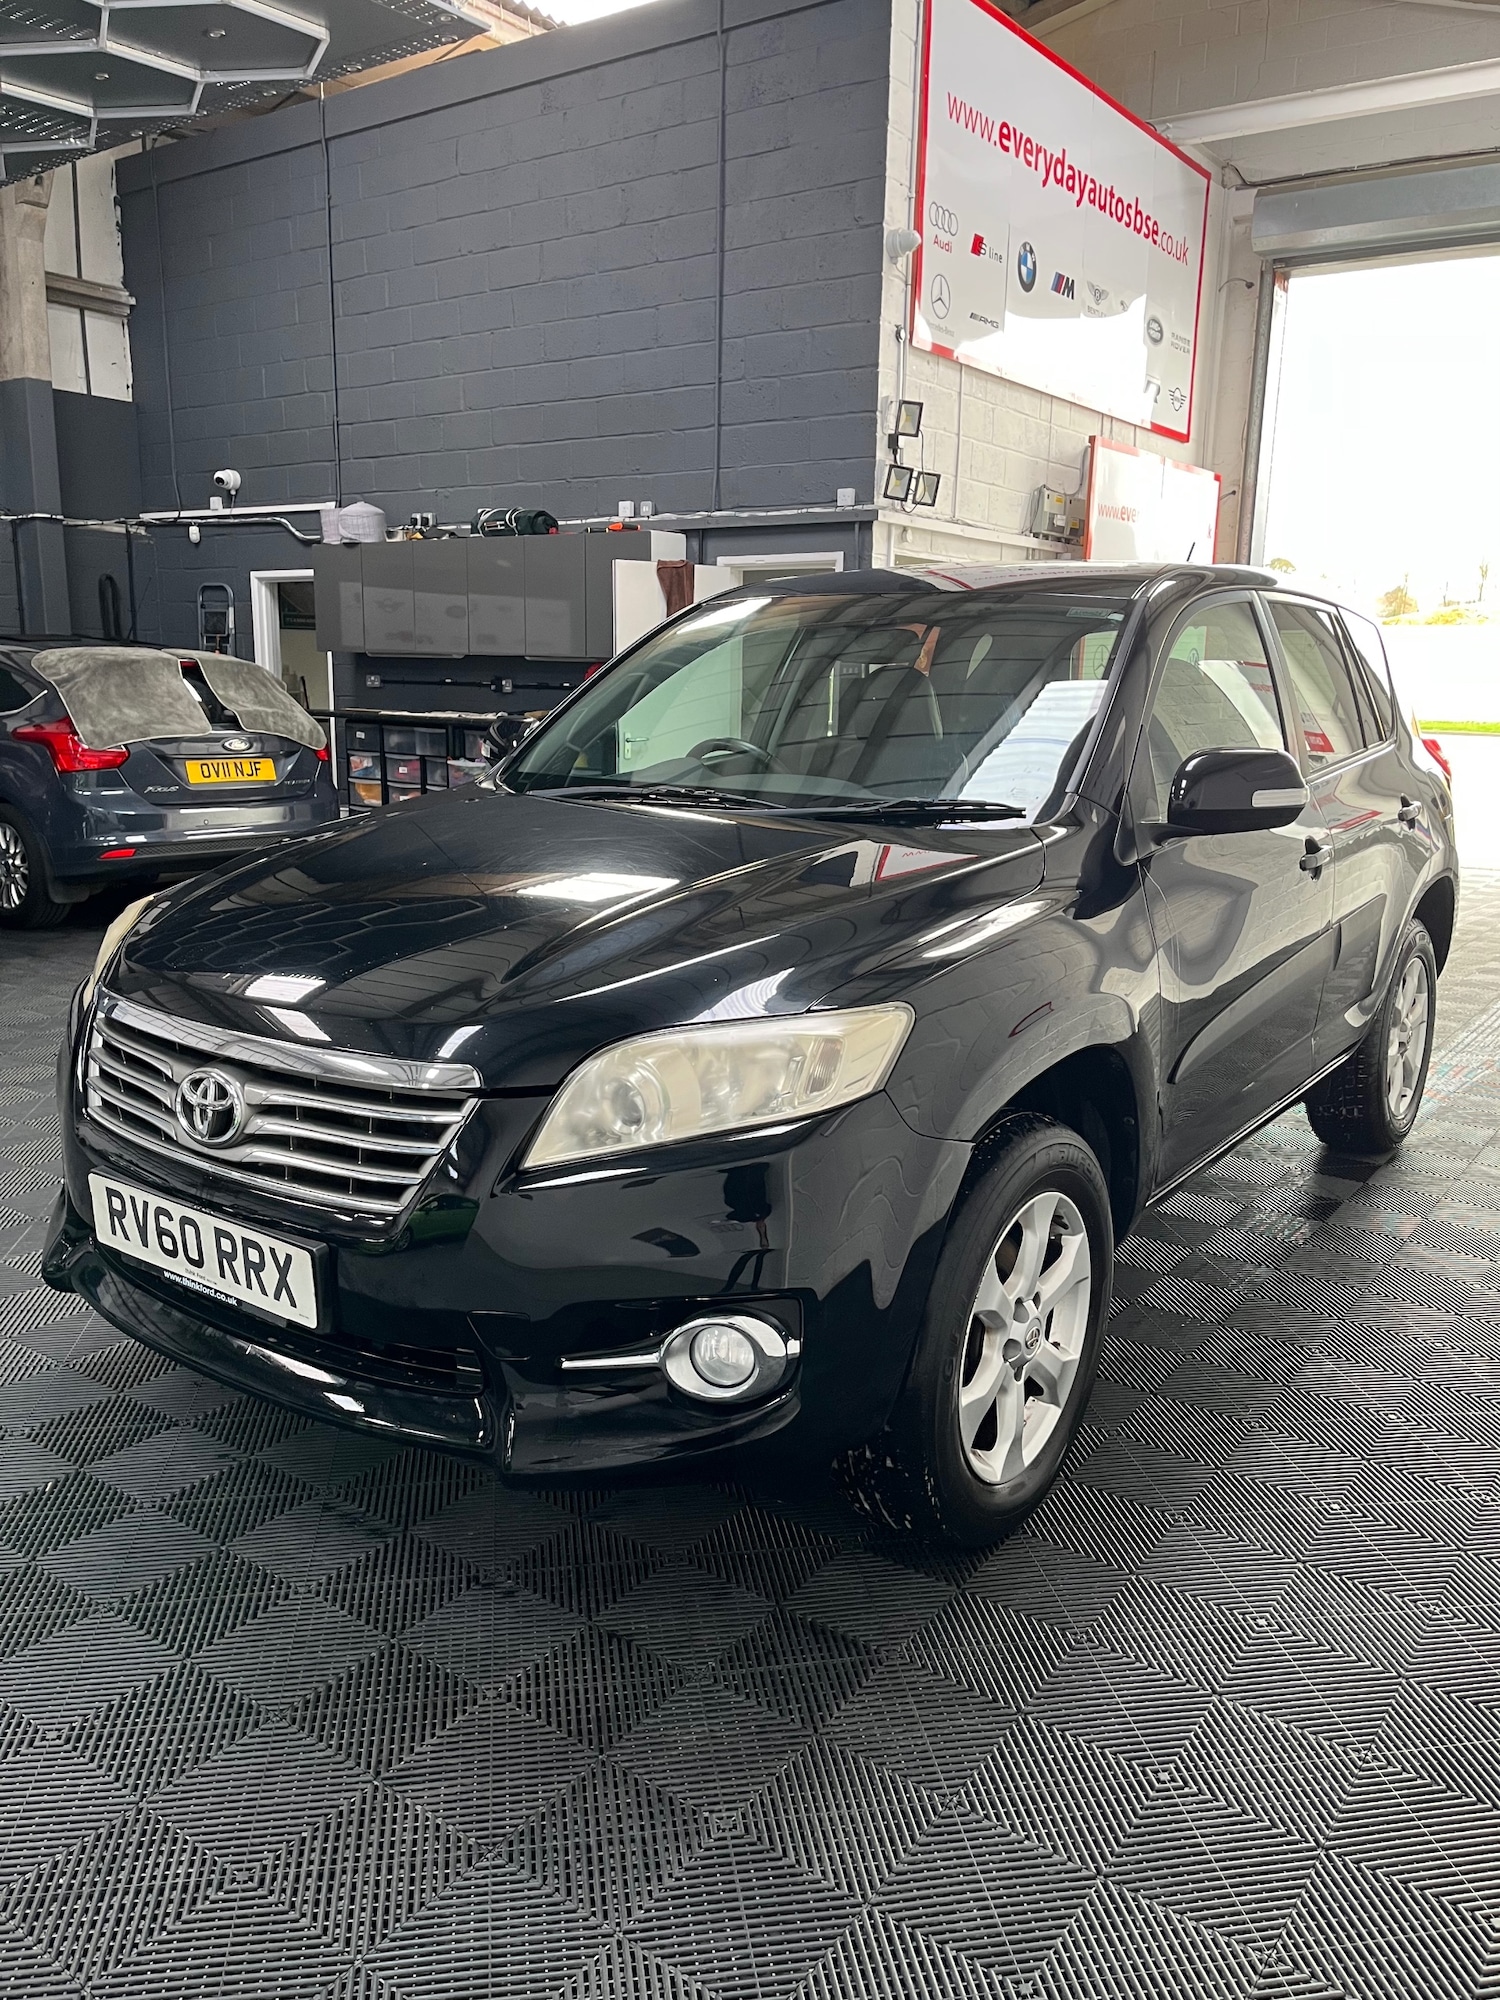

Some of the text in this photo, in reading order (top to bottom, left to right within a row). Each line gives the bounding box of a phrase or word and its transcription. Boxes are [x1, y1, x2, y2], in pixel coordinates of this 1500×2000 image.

[947, 91, 1189, 266] www.everydayautosbse.co.uk
[933, 234, 953, 254] Audi
[989, 246, 1003, 264] line
[1061, 276, 1075, 301] M
[200, 761, 262, 779] OV11 NJF
[105, 1186, 297, 1309] RV60 RRX
[163, 1270, 238, 1307] www.thinkford.co.uk
